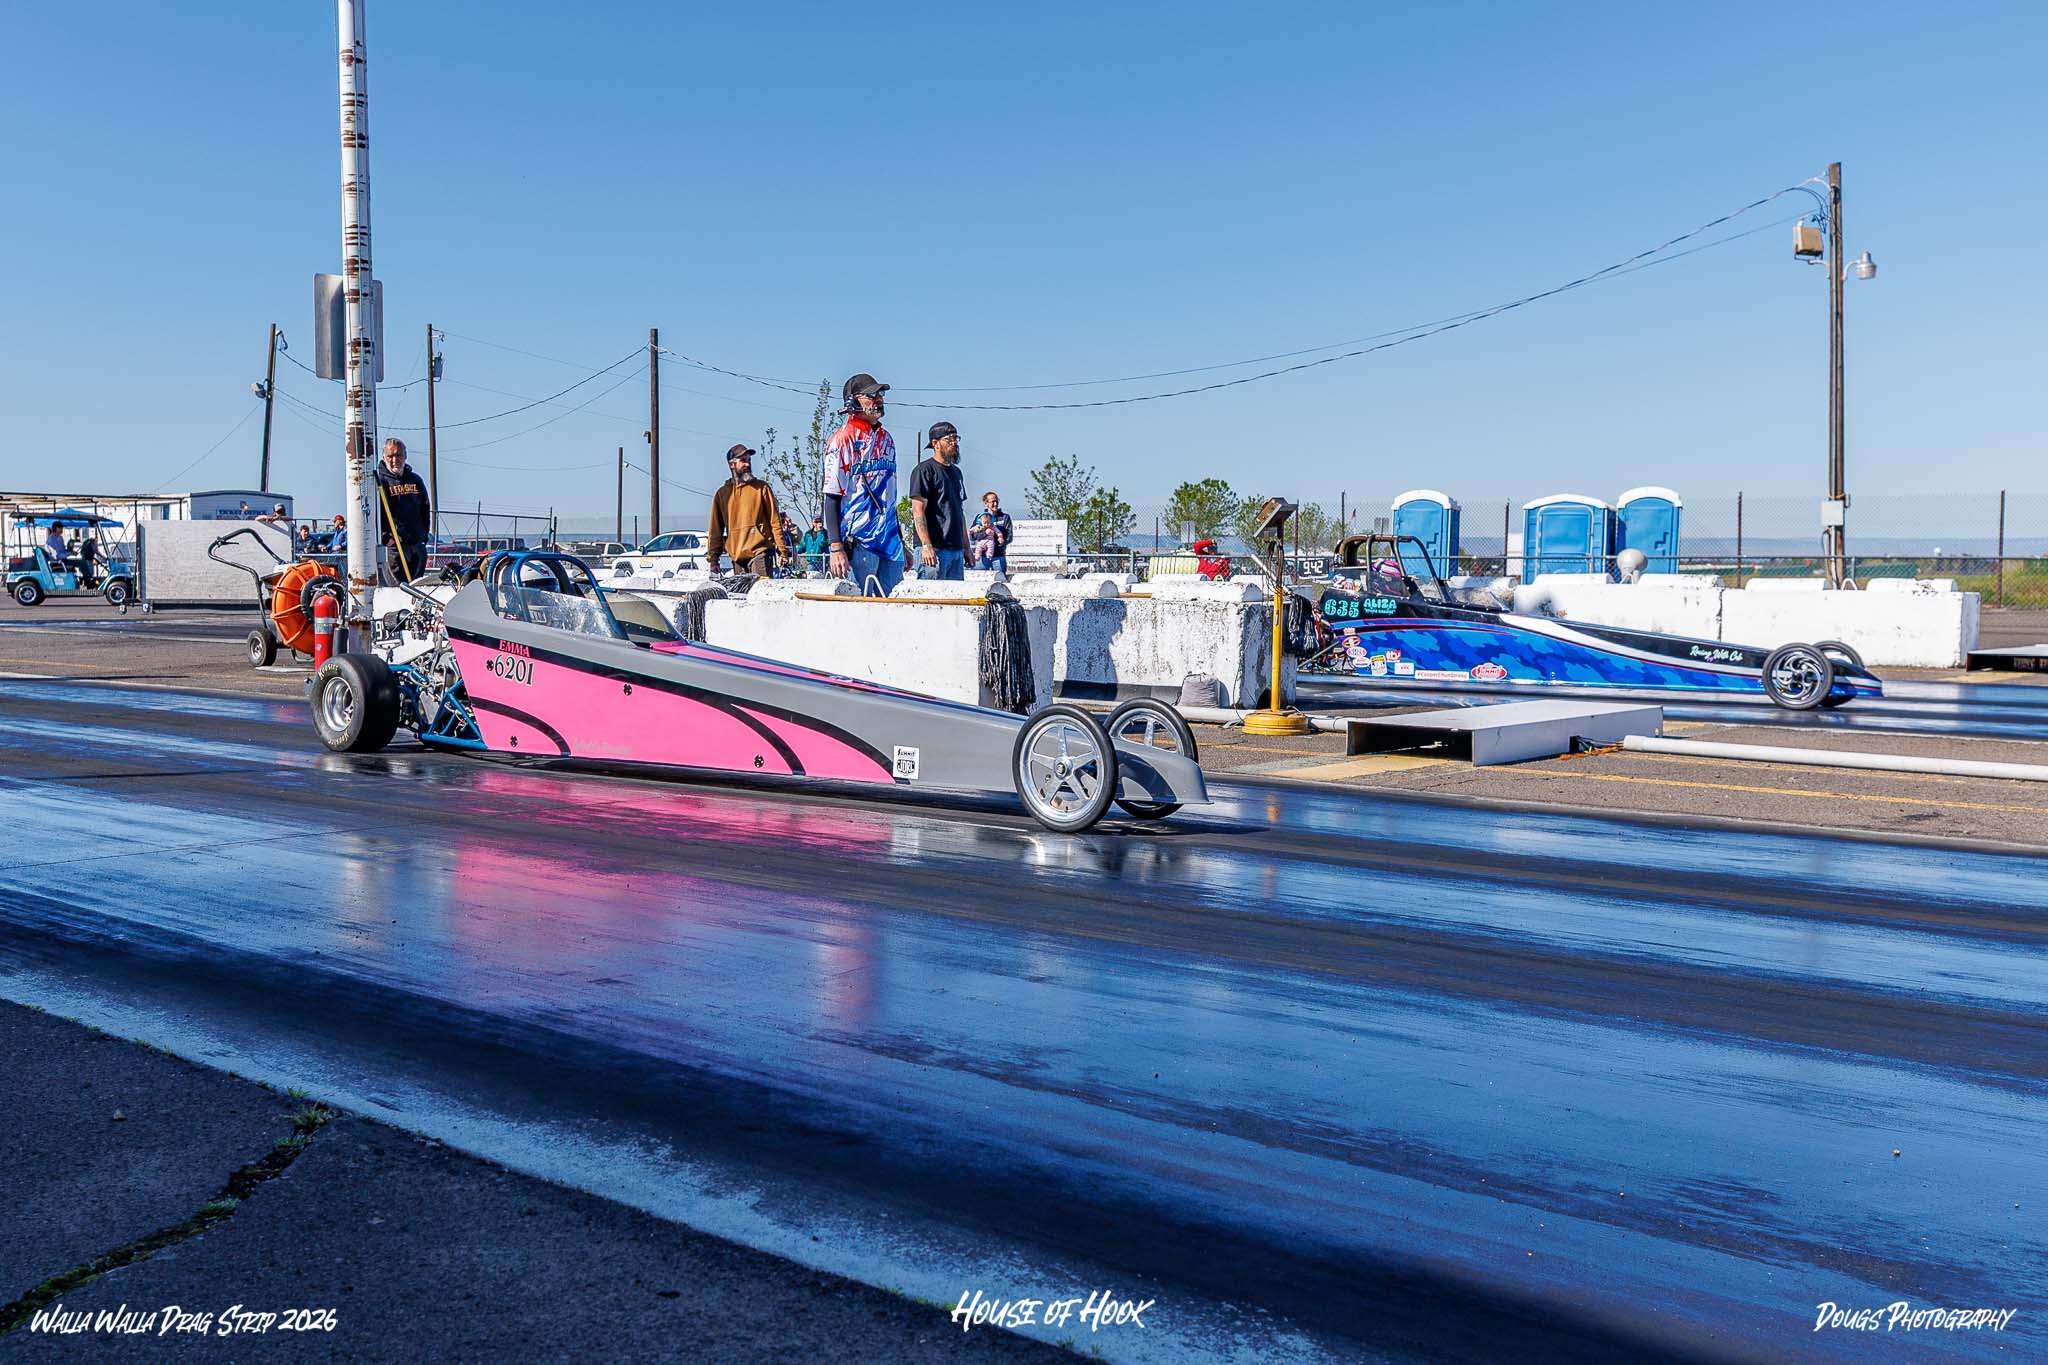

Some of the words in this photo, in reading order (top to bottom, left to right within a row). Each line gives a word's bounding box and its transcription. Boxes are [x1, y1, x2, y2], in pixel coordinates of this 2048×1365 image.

[1324, 599, 1359, 617] 635
[1363, 598, 1397, 609] ALIZA
[499, 640, 531, 658] EMMA
[494, 654, 534, 685] 6201
